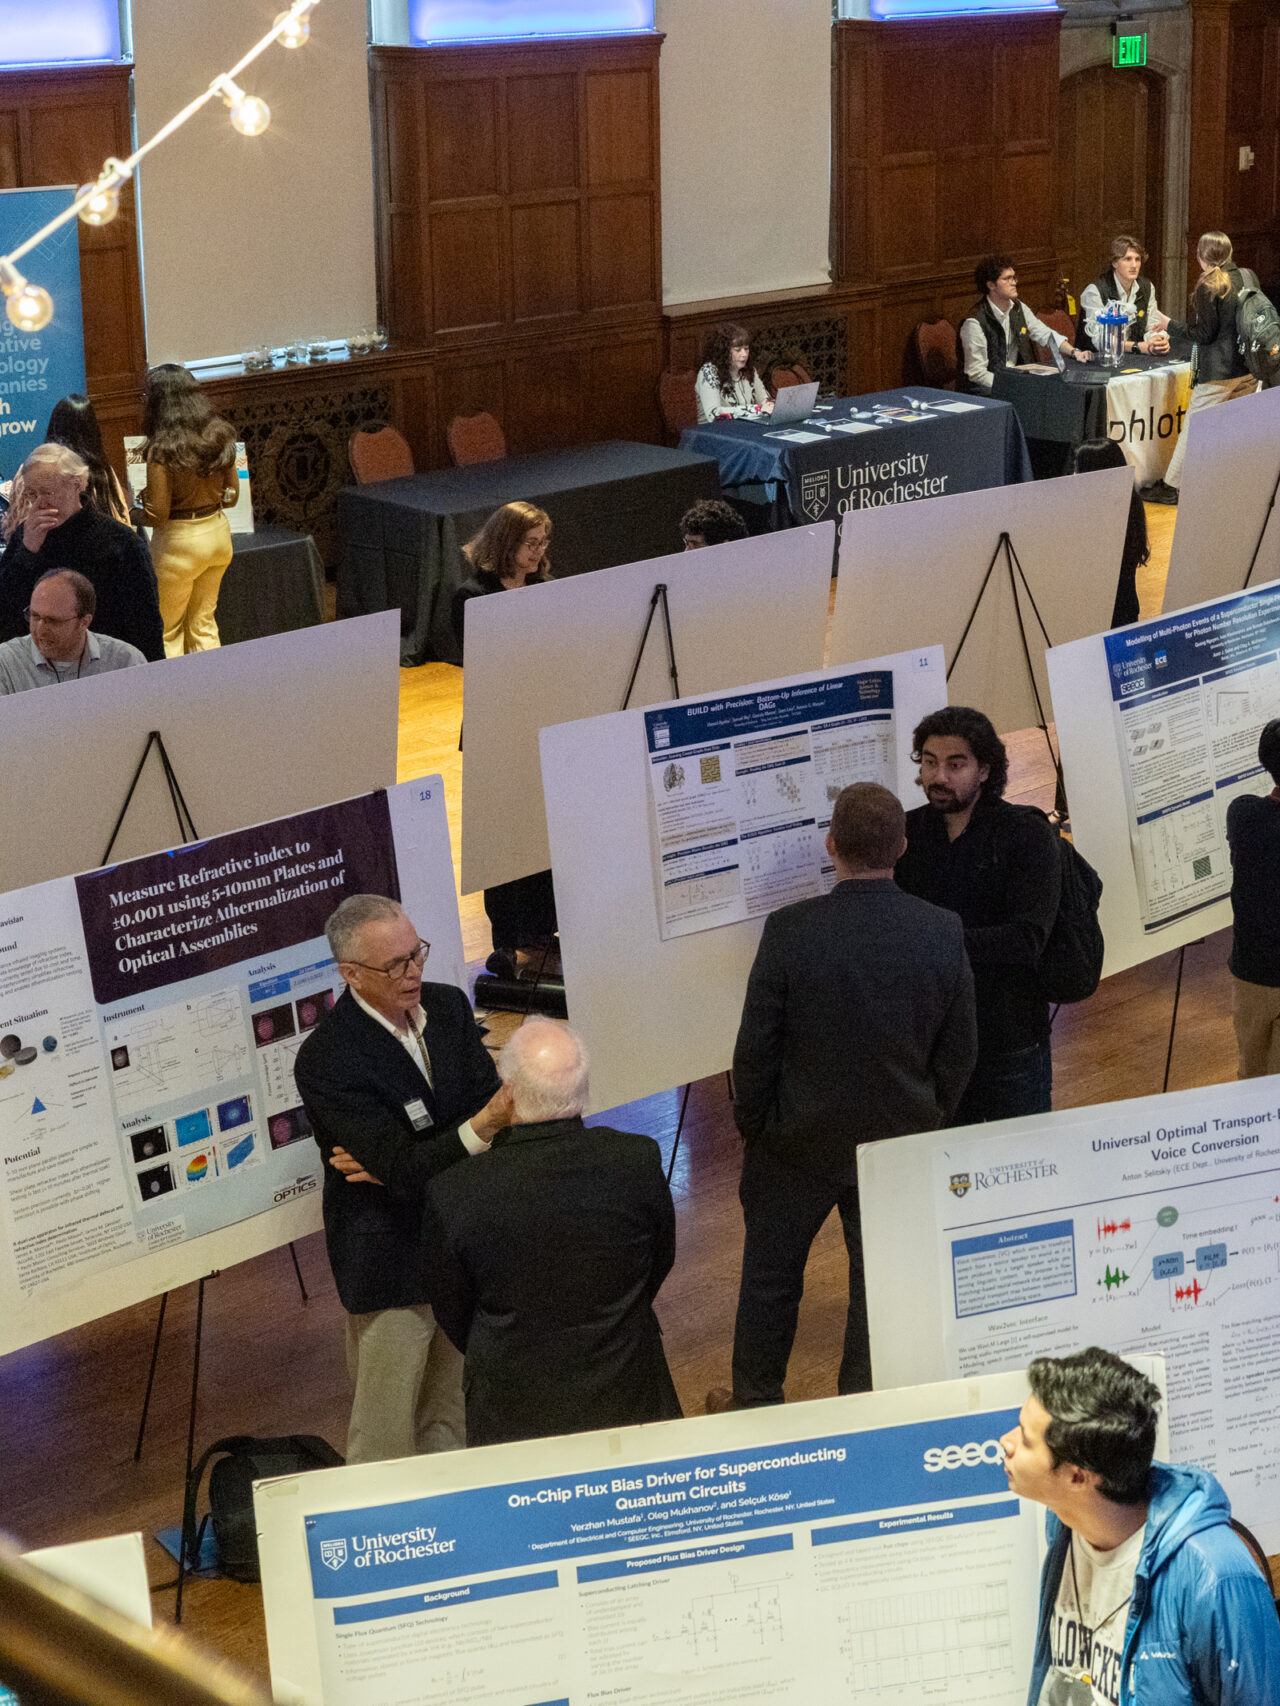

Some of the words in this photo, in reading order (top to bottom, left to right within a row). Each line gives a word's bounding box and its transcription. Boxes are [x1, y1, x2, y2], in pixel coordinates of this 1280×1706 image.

[1119, 36, 1142, 64] EXIT
[0, 376, 48, 394] anies
[0, 419, 37, 438] row
[804, 475, 827, 484] MELIORA
[836, 452, 929, 489] University
[837, 489, 856, 516] of
[860, 475, 948, 510] Rochester
[1125, 634, 1152, 648] Modelling
[1159, 621, 1191, 638] Multi-Photon
[1191, 617, 1210, 630] Events
[1185, 631, 1193, 640] for
[1193, 626, 1212, 638] Photon
[1212, 620, 1231, 633] Number
[919, 658, 928, 667] 11
[1122, 657, 1147, 670] University
[1155, 655, 1168, 666] ECE
[687, 705, 709, 716] BUILD
[710, 703, 724, 712] with
[725, 698, 754, 711] Precision:
[756, 690, 790, 705] Bottom-Up
[791, 686, 818, 699] Inference
[819, 684, 826, 693] of
[826, 681, 844, 693] Linear
[758, 701, 776, 712] DAGs
[419, 789, 432, 802] 18
[108, 880, 176, 908] Measure
[178, 858, 253, 890] Refractive
[254, 846, 293, 867] index
[295, 841, 311, 854] to
[112, 904, 165, 930] ±0.001
[168, 893, 211, 914] using
[211, 875, 271, 901] 5-10mm
[273, 859, 316, 884] Plates
[318, 849, 344, 870] and
[115, 913, 213, 951] Characterize
[215, 878, 329, 924] Athermalization
[330, 869, 347, 887] of
[118, 943, 176, 974] Optical
[178, 921, 259, 957] Assemblies
[248, 962, 277, 978] Analysis
[13, 1008, 49, 1025] Situation
[103, 1004, 146, 1024] Instrument
[120, 1114, 153, 1131] Analysis
[1092, 1131, 1151, 1152] Universal
[1156, 1122, 1207, 1144] Optimal
[4, 1147, 41, 1165] Potential
[1151, 1147, 1187, 1161] Voice
[1192, 1134, 1260, 1154] Conversion
[989, 1160, 1039, 1173] UNIVERSITY
[1122, 1172, 1142, 1181] Anton
[1214, 1153, 1245, 1166] University
[974, 1164, 1058, 1190] ROCHESTER
[274, 1179, 317, 1202] OPTICS
[998, 1232, 1028, 1244] Abstract
[1182, 1231, 1197, 1240] Time
[1198, 1225, 1234, 1238] embedding
[1141, 1324, 1161, 1334] Model
[508, 1487, 572, 1507] On-Chip
[575, 1483, 608, 1498] Flux
[611, 1478, 643, 1493] Bias
[646, 1471, 691, 1488] Driver
[694, 1467, 716, 1481] for
[719, 1447, 847, 1477] Superconducting
[616, 1490, 686, 1510] Quantum
[689, 1480, 746, 1499] Circuits
[879, 1515, 927, 1529] Experimental
[927, 1511, 954, 1523] Results
[352, 1527, 437, 1553] University
[354, 1552, 371, 1568] of
[374, 1539, 456, 1565] Rochester
[626, 1556, 662, 1569] Proposed
[663, 1552, 679, 1562] Flux
[680, 1551, 696, 1560] Bias
[696, 1547, 719, 1558] Driver
[719, 1543, 745, 1555] Design
[424, 1587, 470, 1603] Background
